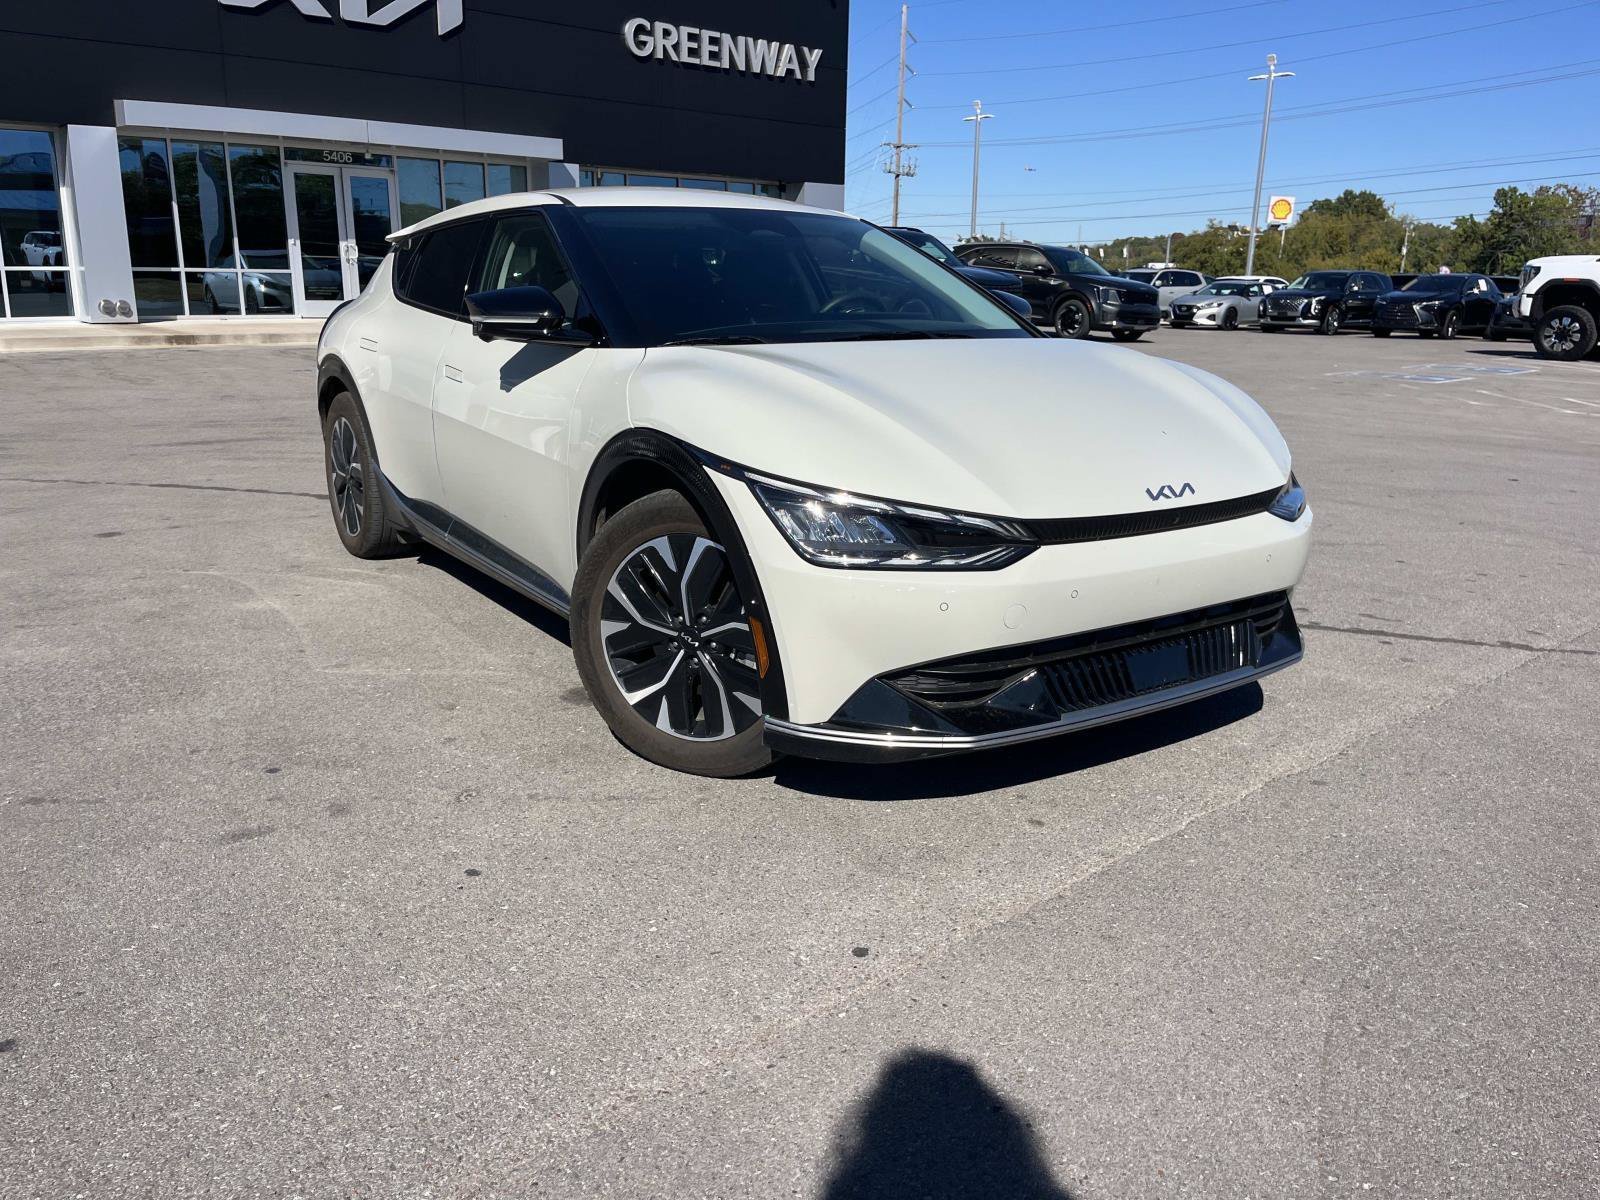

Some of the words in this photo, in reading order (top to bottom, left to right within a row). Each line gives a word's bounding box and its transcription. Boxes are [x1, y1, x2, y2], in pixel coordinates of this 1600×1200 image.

[624, 17, 823, 82] GREENWAY
[323, 150, 353, 163] 5406
[1145, 482, 1196, 501] KIA
